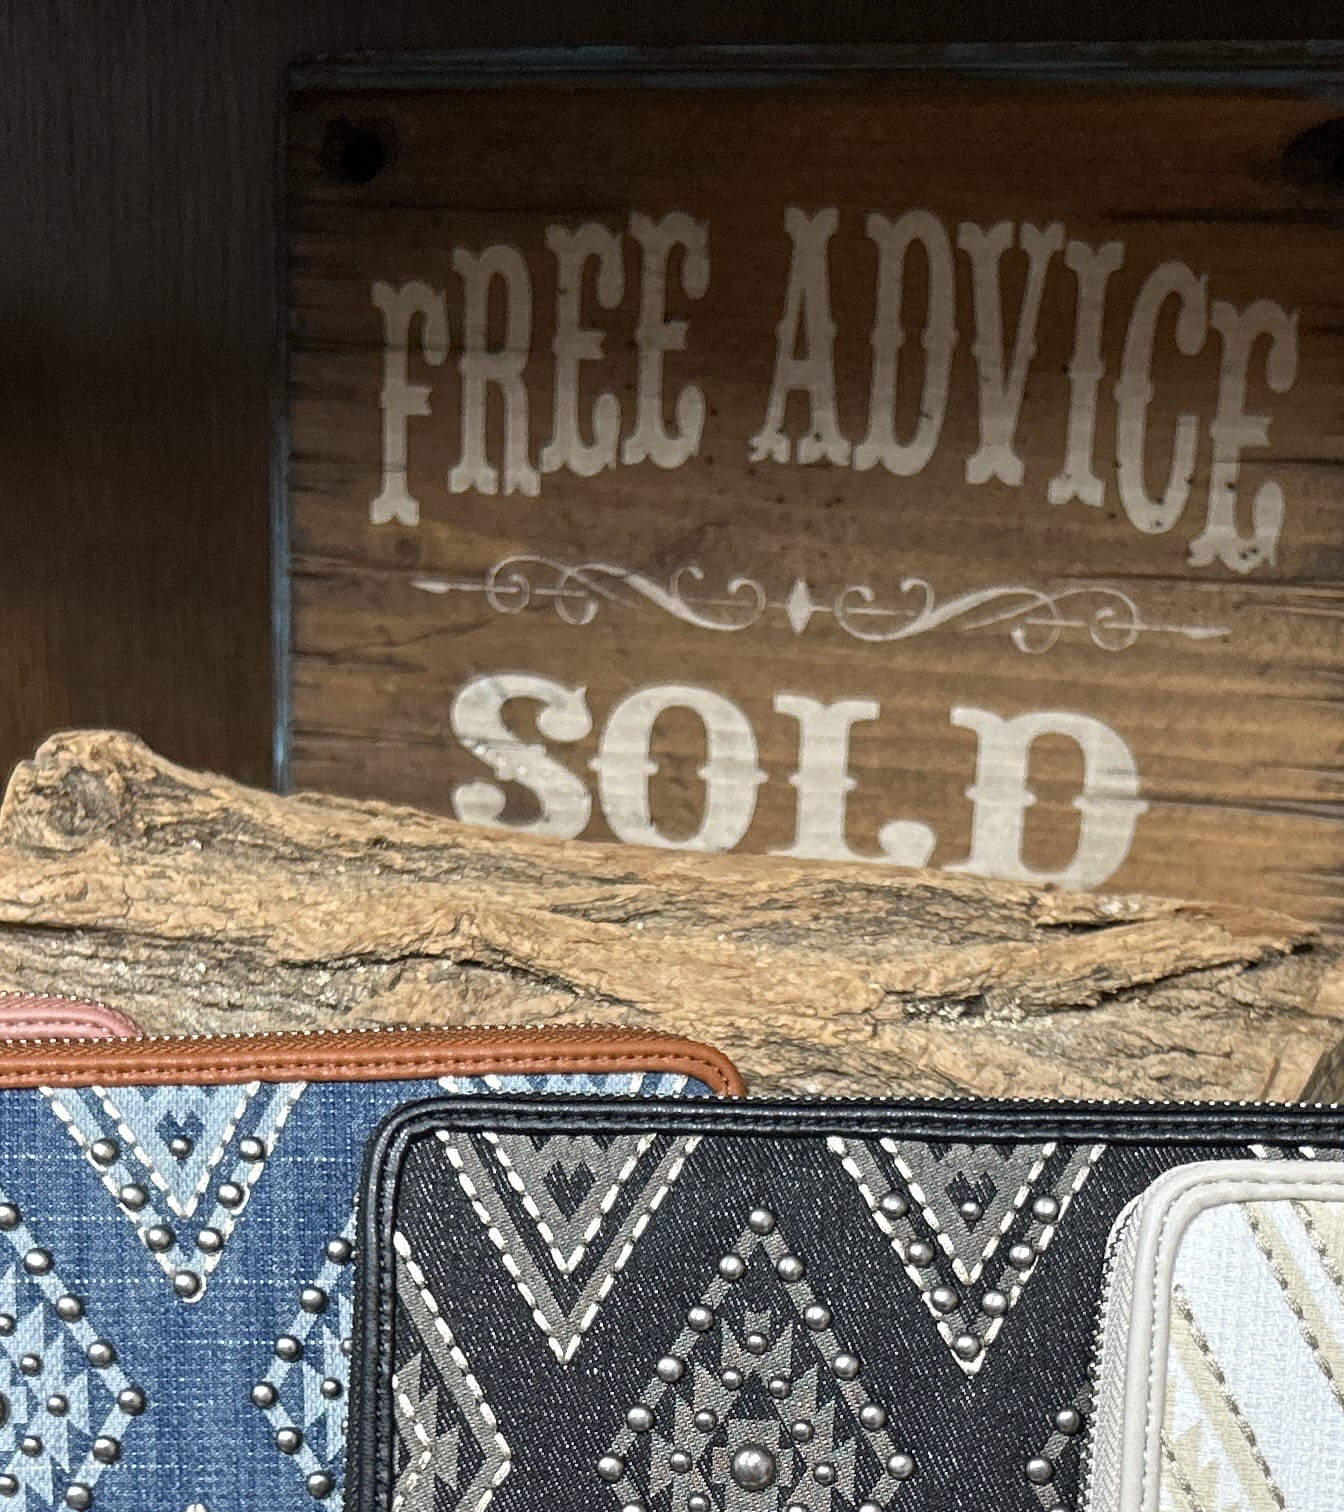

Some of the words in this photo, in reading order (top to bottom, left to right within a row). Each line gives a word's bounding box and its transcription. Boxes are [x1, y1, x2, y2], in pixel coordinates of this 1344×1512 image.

[367, 208, 711, 526] FREE
[748, 205, 1301, 574] ADVICE
[450, 673, 1151, 891] SOLD
